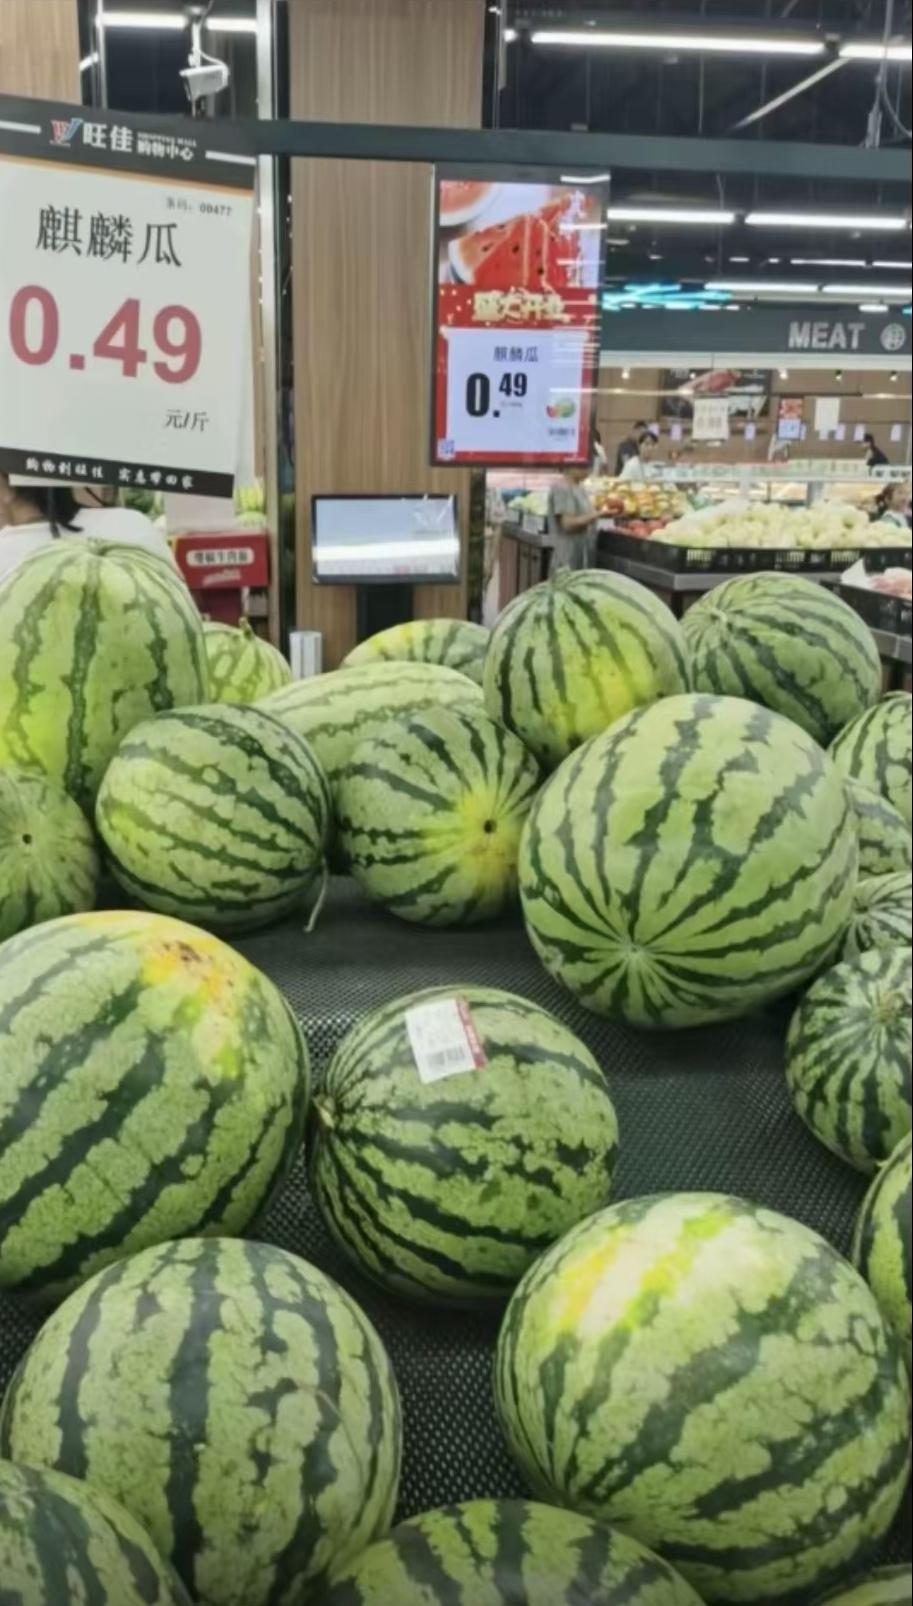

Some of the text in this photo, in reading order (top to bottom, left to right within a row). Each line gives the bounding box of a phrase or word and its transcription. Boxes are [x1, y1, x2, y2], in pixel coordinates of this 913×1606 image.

[82, 122, 133, 153] 旺佳
[137, 139, 194, 161] 购物中心
[35, 203, 183, 268] 麒麟瓜
[8, 284, 202, 384] 0.49
[788, 321, 866, 349] MEAT
[465, 372, 528, 418] 0.49
[164, 409, 209, 432] 元/斤
